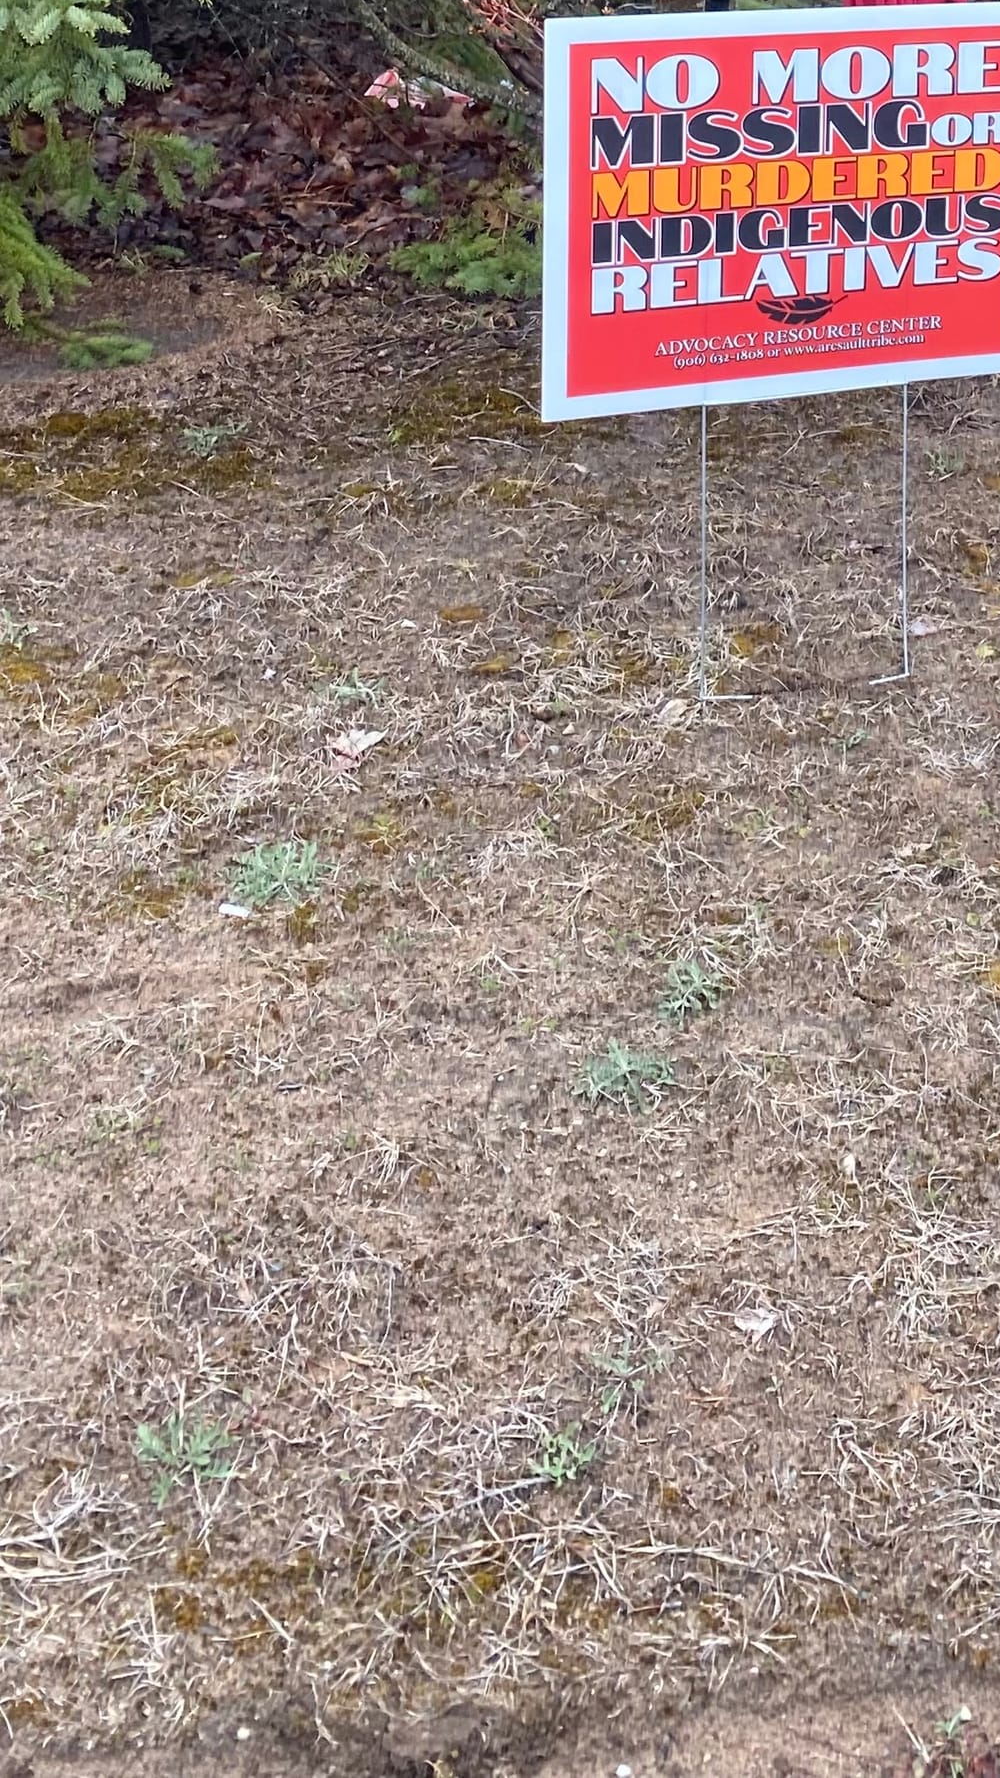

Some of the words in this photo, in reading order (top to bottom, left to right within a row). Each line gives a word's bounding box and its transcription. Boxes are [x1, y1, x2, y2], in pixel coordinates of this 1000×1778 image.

[590, 53, 720, 115] NO
[590, 100, 930, 170] MISSING
[654, 332, 758, 357] ADVOCACY
[763, 322, 862, 345] RESOURCE
[867, 315, 942, 335] CENTER
[673, 354, 706, 370] (906)
[709, 350, 764, 364] 632-1808
[768, 348, 780, 358] or
